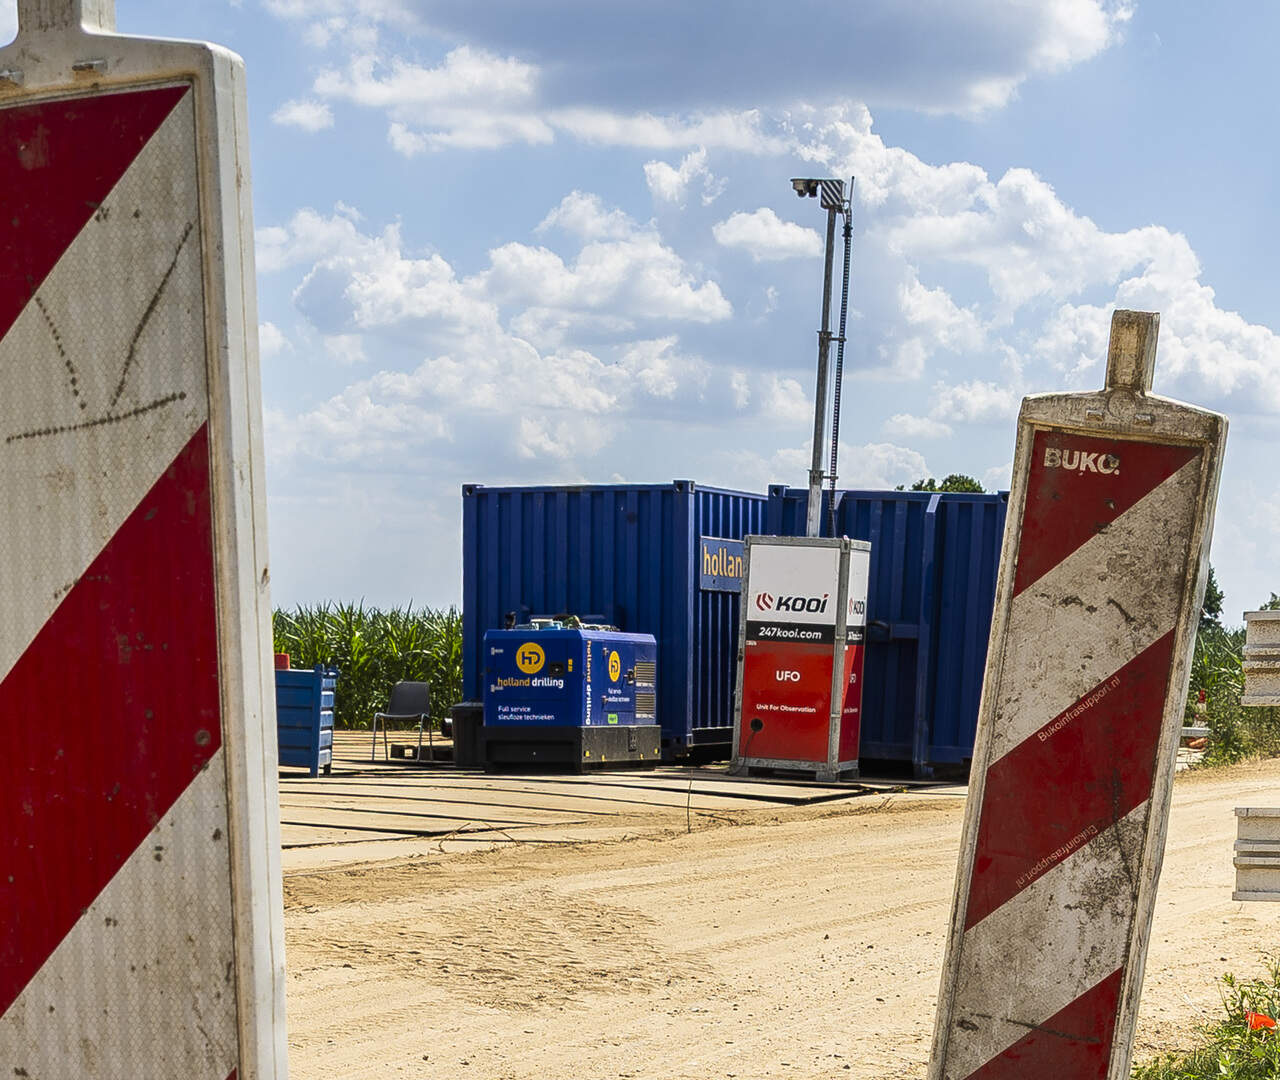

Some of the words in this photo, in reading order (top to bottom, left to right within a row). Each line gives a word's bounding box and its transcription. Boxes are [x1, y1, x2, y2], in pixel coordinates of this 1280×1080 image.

[758, 627, 822, 639] 247kooi.com
[521, 651, 541, 665] HD
[775, 670, 801, 682] UFO
[498, 677, 530, 687] holland
[532, 677, 564, 689] drilling
[510, 705, 532, 713] service
[756, 703, 769, 711] Unit
[769, 704, 780, 712] For
[780, 704, 817, 714] Observation
